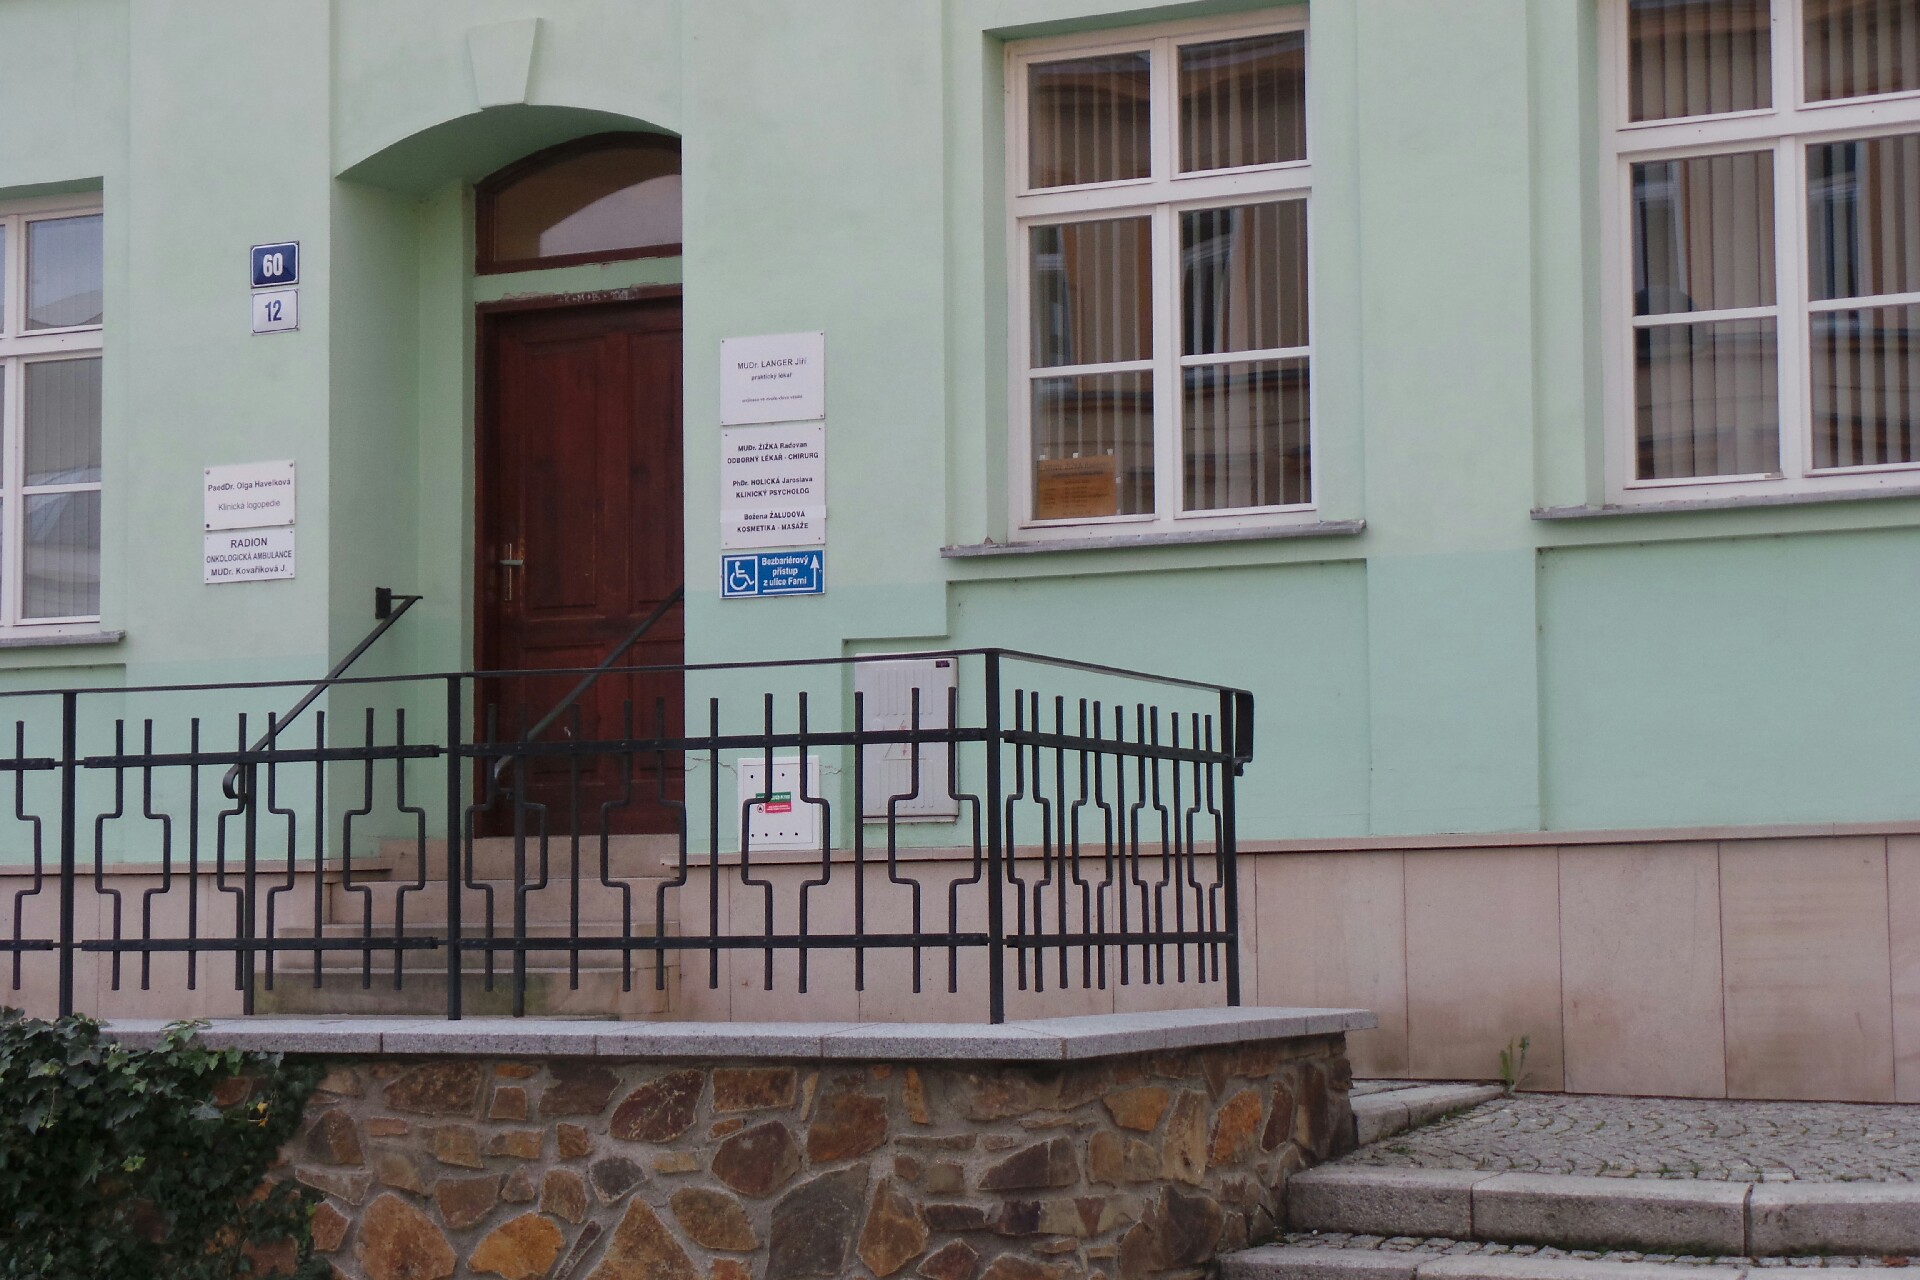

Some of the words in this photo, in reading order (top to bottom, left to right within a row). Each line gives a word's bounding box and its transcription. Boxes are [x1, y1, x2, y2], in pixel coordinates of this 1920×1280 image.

[263, 252, 283, 278] 60
[265, 299, 282, 322] 12
[737, 361, 759, 370] MUDr.
[761, 358, 793, 368] LANGER
[738, 444, 757, 452] MUDr.
[779, 441, 808, 449] Radovan
[727, 455, 759, 464] ODBORNÝ
[761, 453, 783, 462] LÉKAŘ
[788, 452, 819, 460] CHIRURG
[208, 483, 235, 492] PaedDr.
[236, 482, 253, 491] Olga
[254, 478, 291, 488] Havelková
[750, 476, 780, 486] HOLICKÁ
[735, 489, 767, 498] KLINICKÝ
[769, 487, 810, 496] PSYCHOLOG
[218, 503, 245, 511] Klinická
[246, 500, 281, 510] logopedie
[744, 512, 768, 520] Božena
[769, 510, 806, 519] ŽALUDOVÁ
[737, 524, 776, 533] KOSMETIKA
[781, 521, 809, 530] MASÁŽE
[230, 537, 268, 549] RADION
[206, 552, 252, 563] ONKOLOGICKÁ
[252, 549, 292, 560] AMBULANCE
[761, 555, 809, 566] Bezbariérový
[210, 567, 234, 576] MUDr.
[280, 564, 288, 572] J.
[772, 566, 799, 577] přístup
[769, 577, 787, 586] ulice
